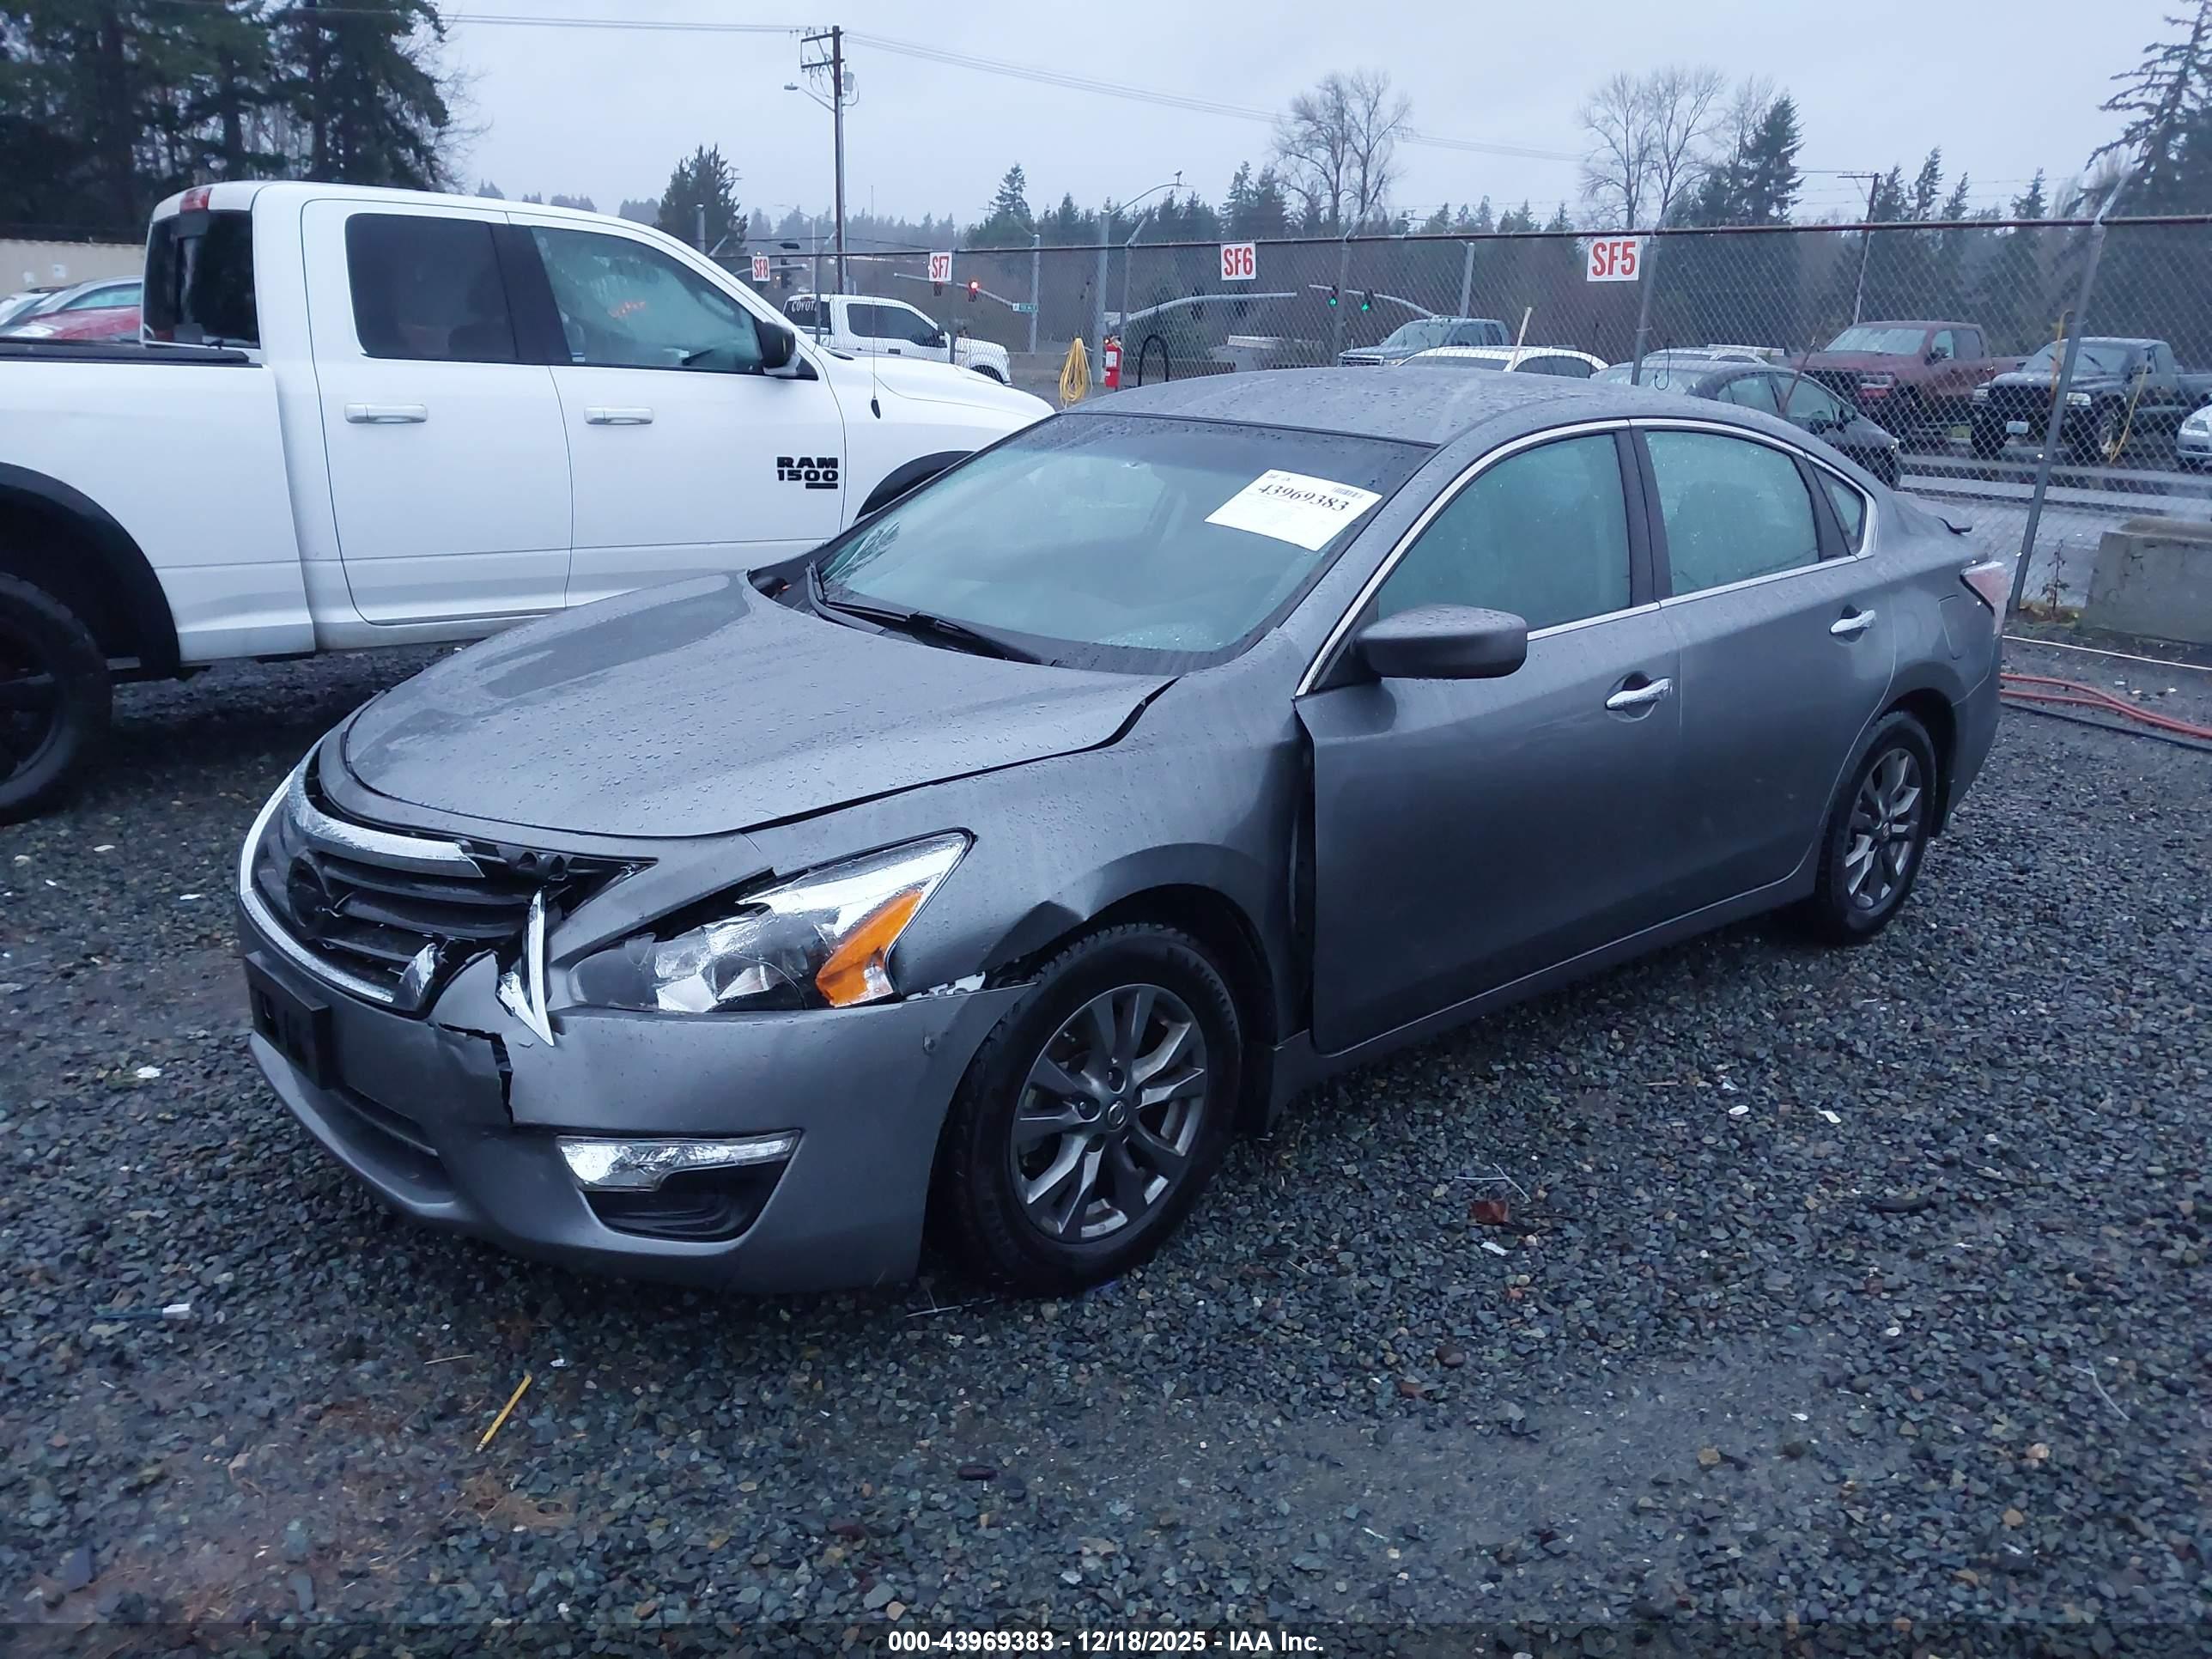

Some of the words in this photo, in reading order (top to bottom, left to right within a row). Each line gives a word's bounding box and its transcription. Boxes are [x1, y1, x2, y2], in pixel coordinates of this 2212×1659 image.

[753, 258, 769, 279] SF8
[932, 255, 950, 279] SF7
[1224, 246, 1254, 276] SF6
[1592, 241, 1636, 276] SF5
[791, 301, 817, 313] COYOT
[776, 456, 838, 469] RAM
[777, 469, 839, 482] 1500
[1258, 483, 1350, 512] 43969383
